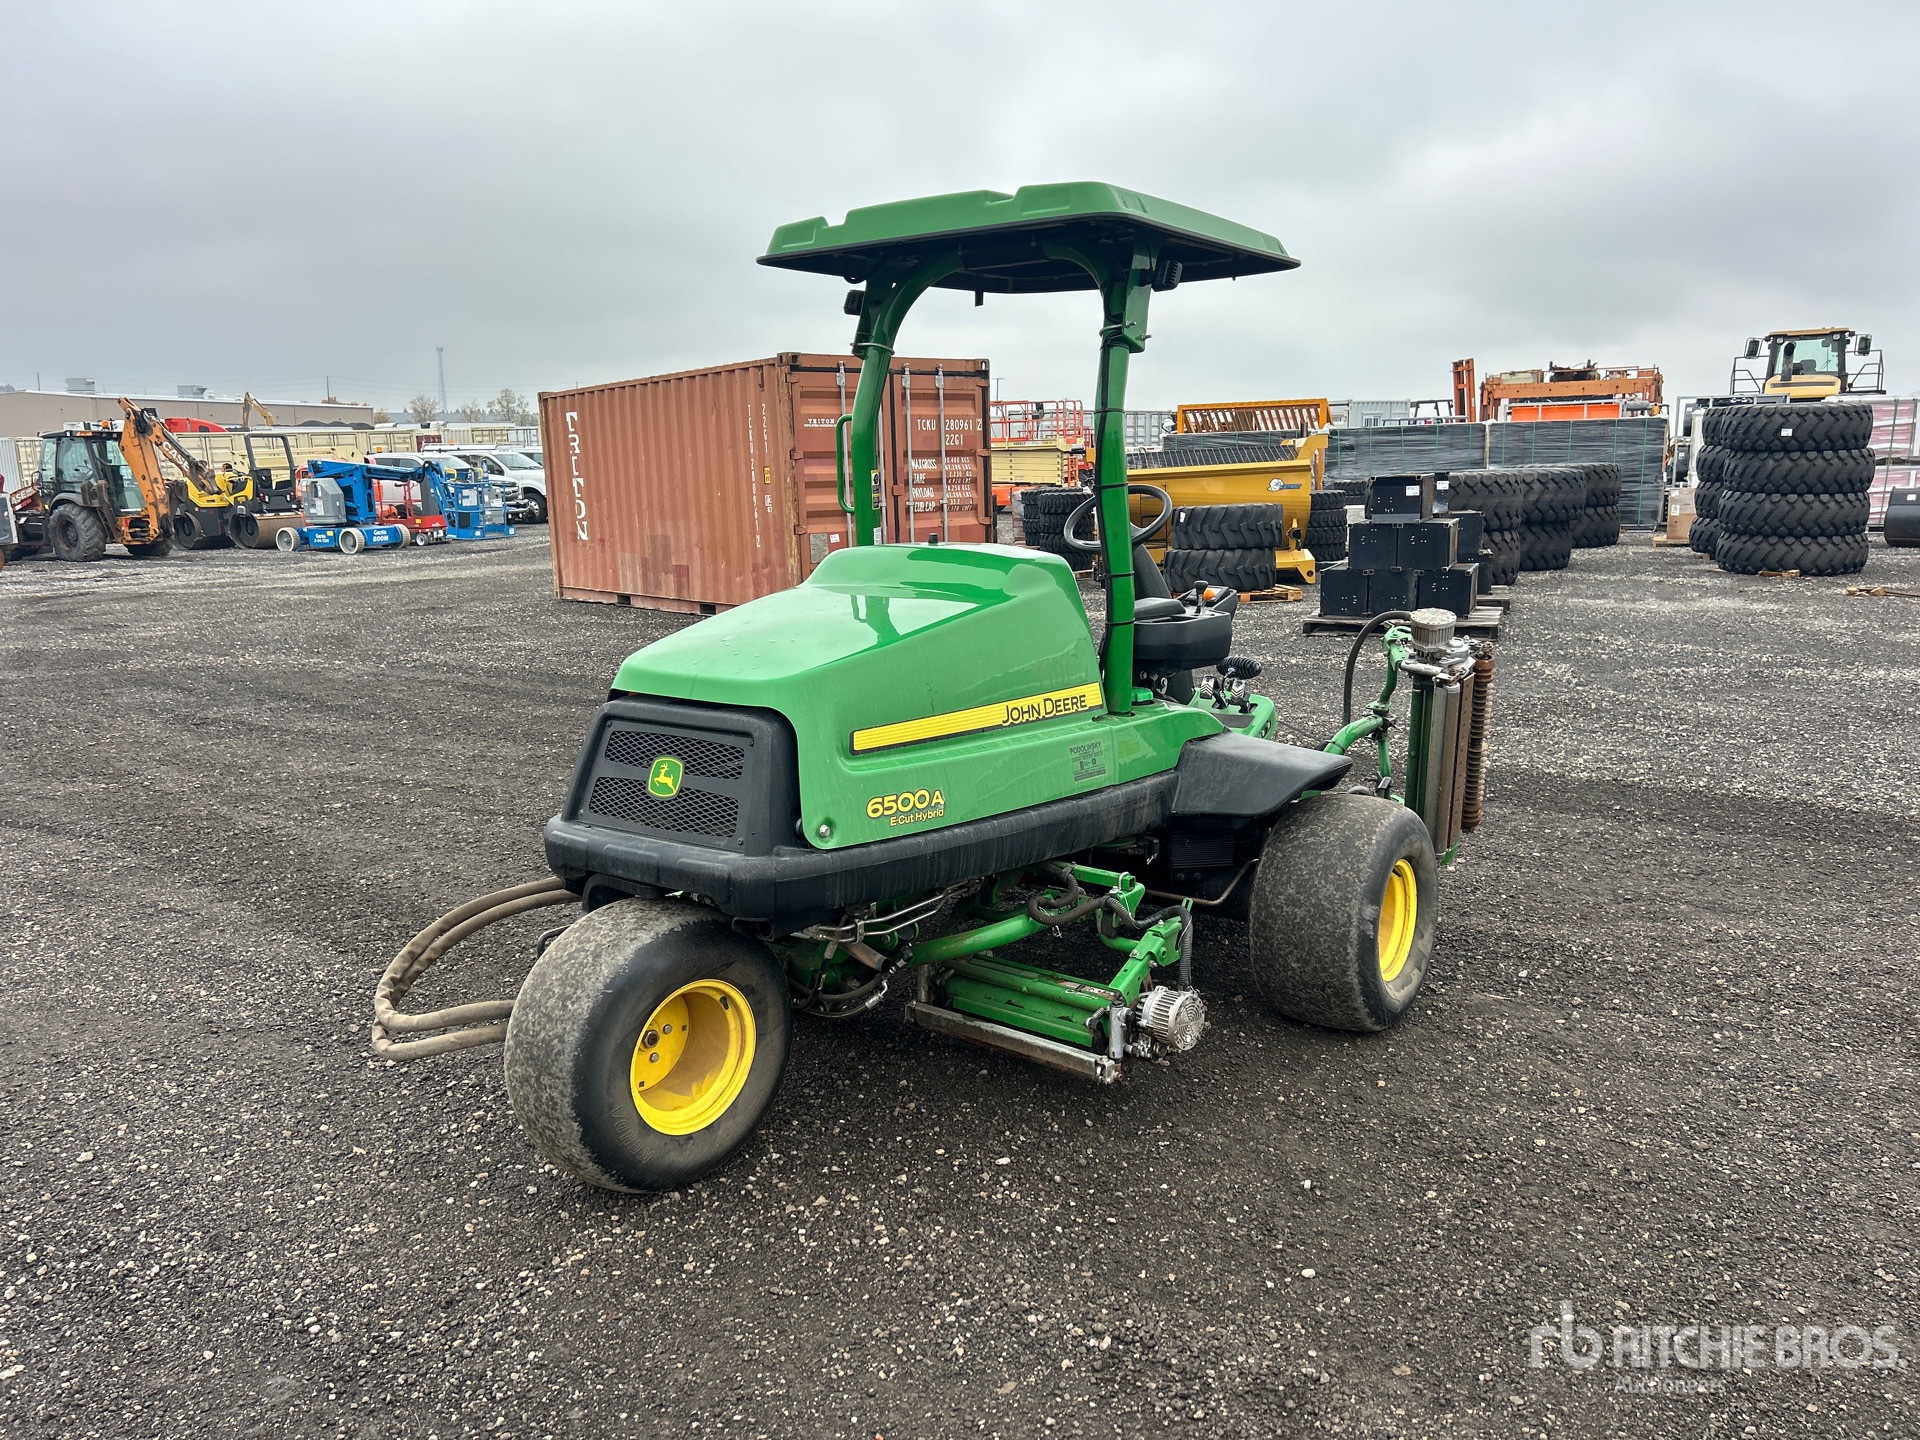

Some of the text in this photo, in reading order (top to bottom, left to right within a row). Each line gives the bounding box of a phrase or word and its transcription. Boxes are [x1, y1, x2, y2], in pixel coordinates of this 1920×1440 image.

[917, 418, 983, 431] TCKU 280961 2
[945, 433, 964, 446] 22G1
[163, 441, 191, 471] CASE
[565, 411, 589, 541] TRITON
[913, 472, 926, 484] TARE
[750, 457, 759, 532] 280961
[912, 487, 935, 499] PAYLOAD
[372, 535, 389, 543] BOOM
[1002, 694, 1088, 724] JOHN DEERE
[915, 807, 945, 824] Hybrid
[610, 1105, 655, 1164] KENDA
